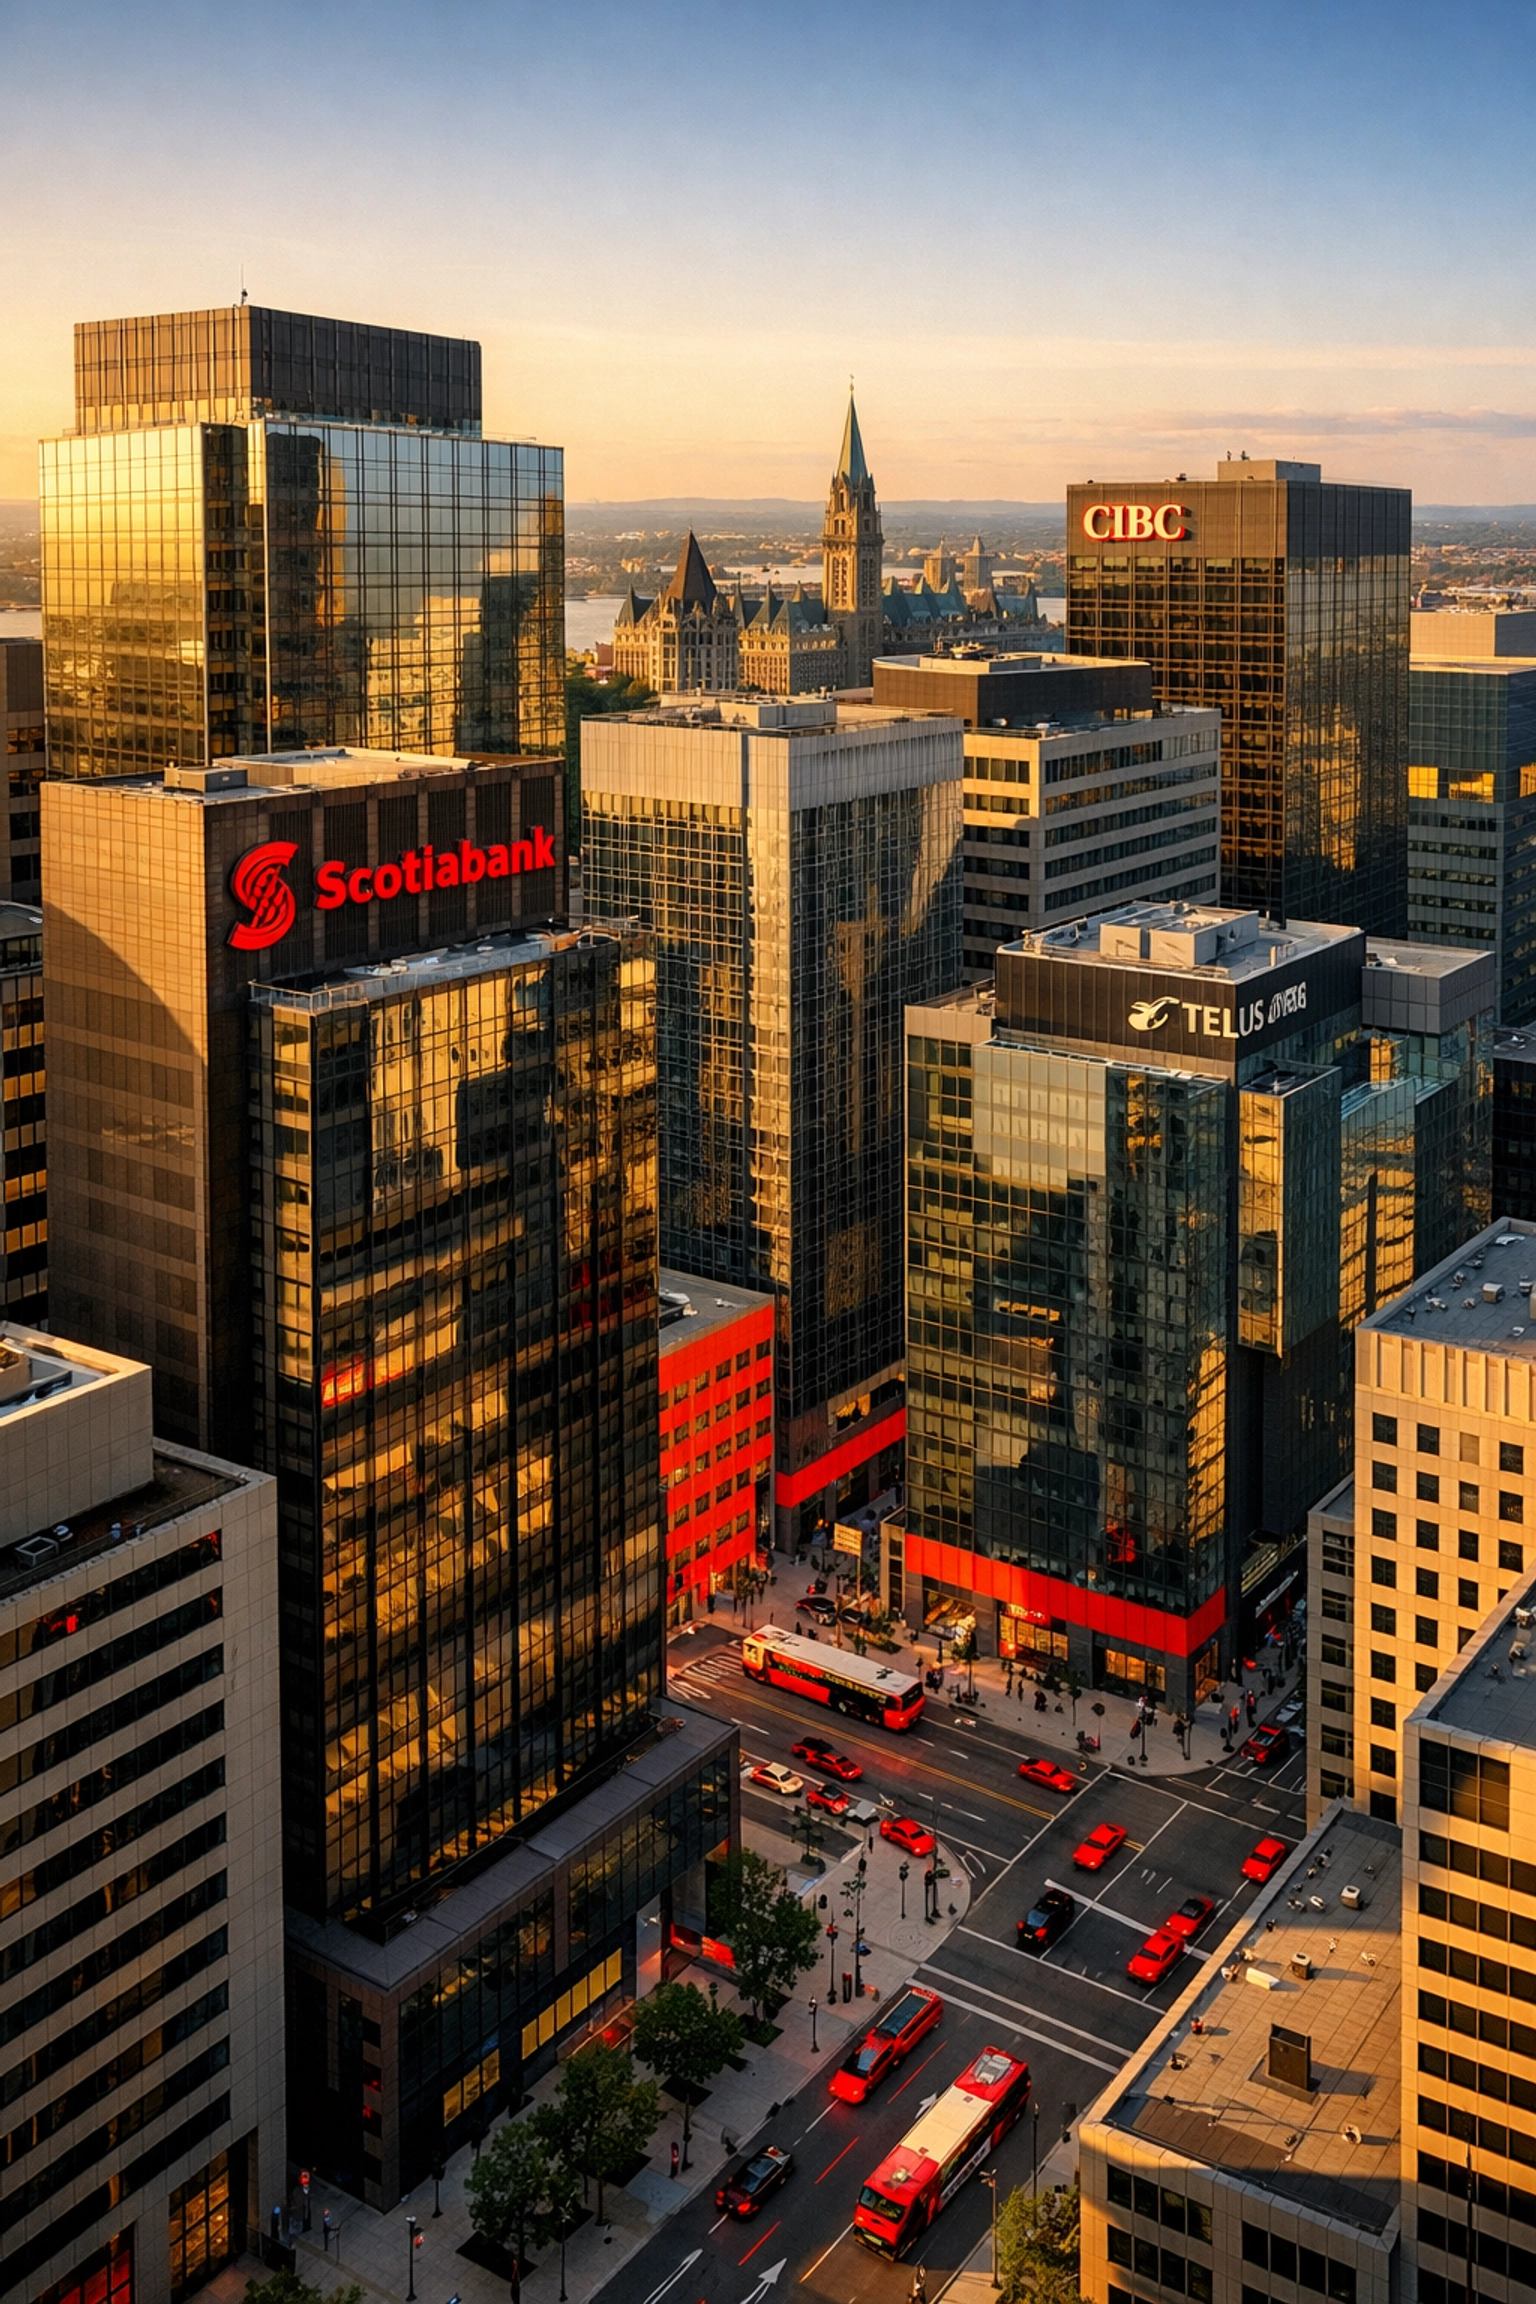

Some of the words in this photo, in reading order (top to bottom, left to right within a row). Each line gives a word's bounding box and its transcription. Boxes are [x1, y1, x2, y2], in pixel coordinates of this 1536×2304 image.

[1083, 504, 1184, 540] CIBC
[315, 825, 556, 910] Scotiabank
[1181, 999, 1264, 1039] TELUS
